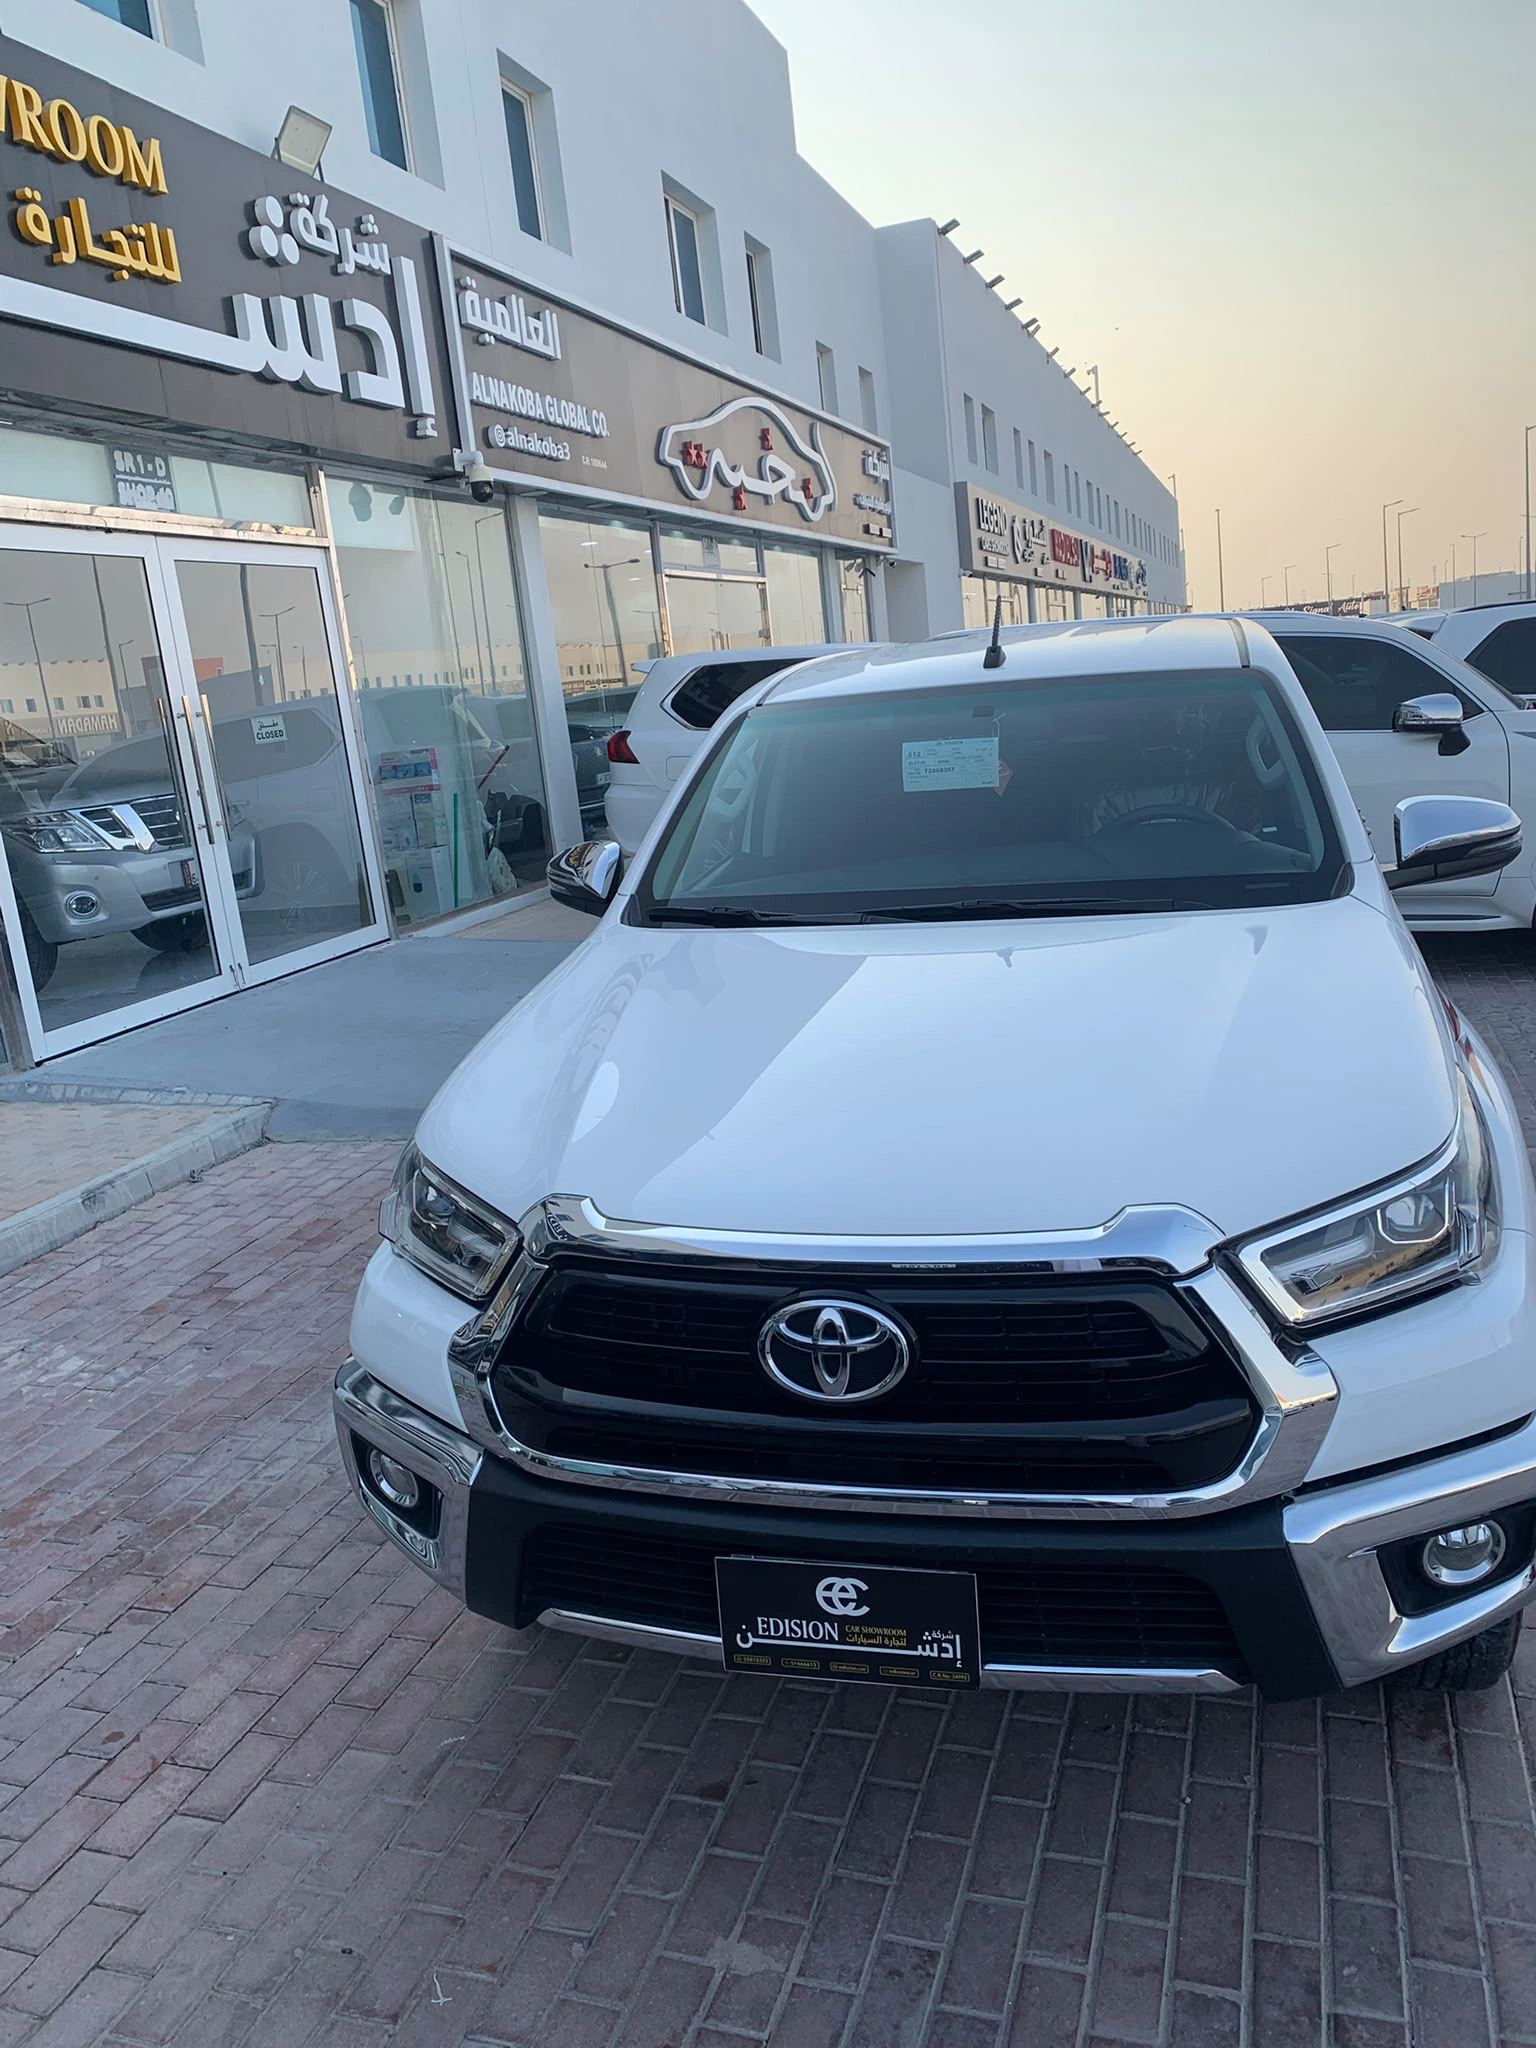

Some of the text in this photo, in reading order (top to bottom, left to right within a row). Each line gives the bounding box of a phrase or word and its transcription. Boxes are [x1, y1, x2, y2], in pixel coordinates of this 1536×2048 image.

[15, 186, 182, 283] للتجارة
[290, 192, 392, 275] شركة
[459, 275, 562, 361] العالمية
[470, 371, 545, 420] ALNAKOBA
[545, 394, 591, 433] GLOBAL
[488, 423, 571, 461] @alnakoba3
[978, 497, 1008, 536] LEGEND
[256, 729, 284, 740] CLOSED
[756, 1616, 839, 1641] EDISION
[845, 1624, 907, 1637] CAR SHOWROOM
[931, 1629, 954, 1641] شركة
